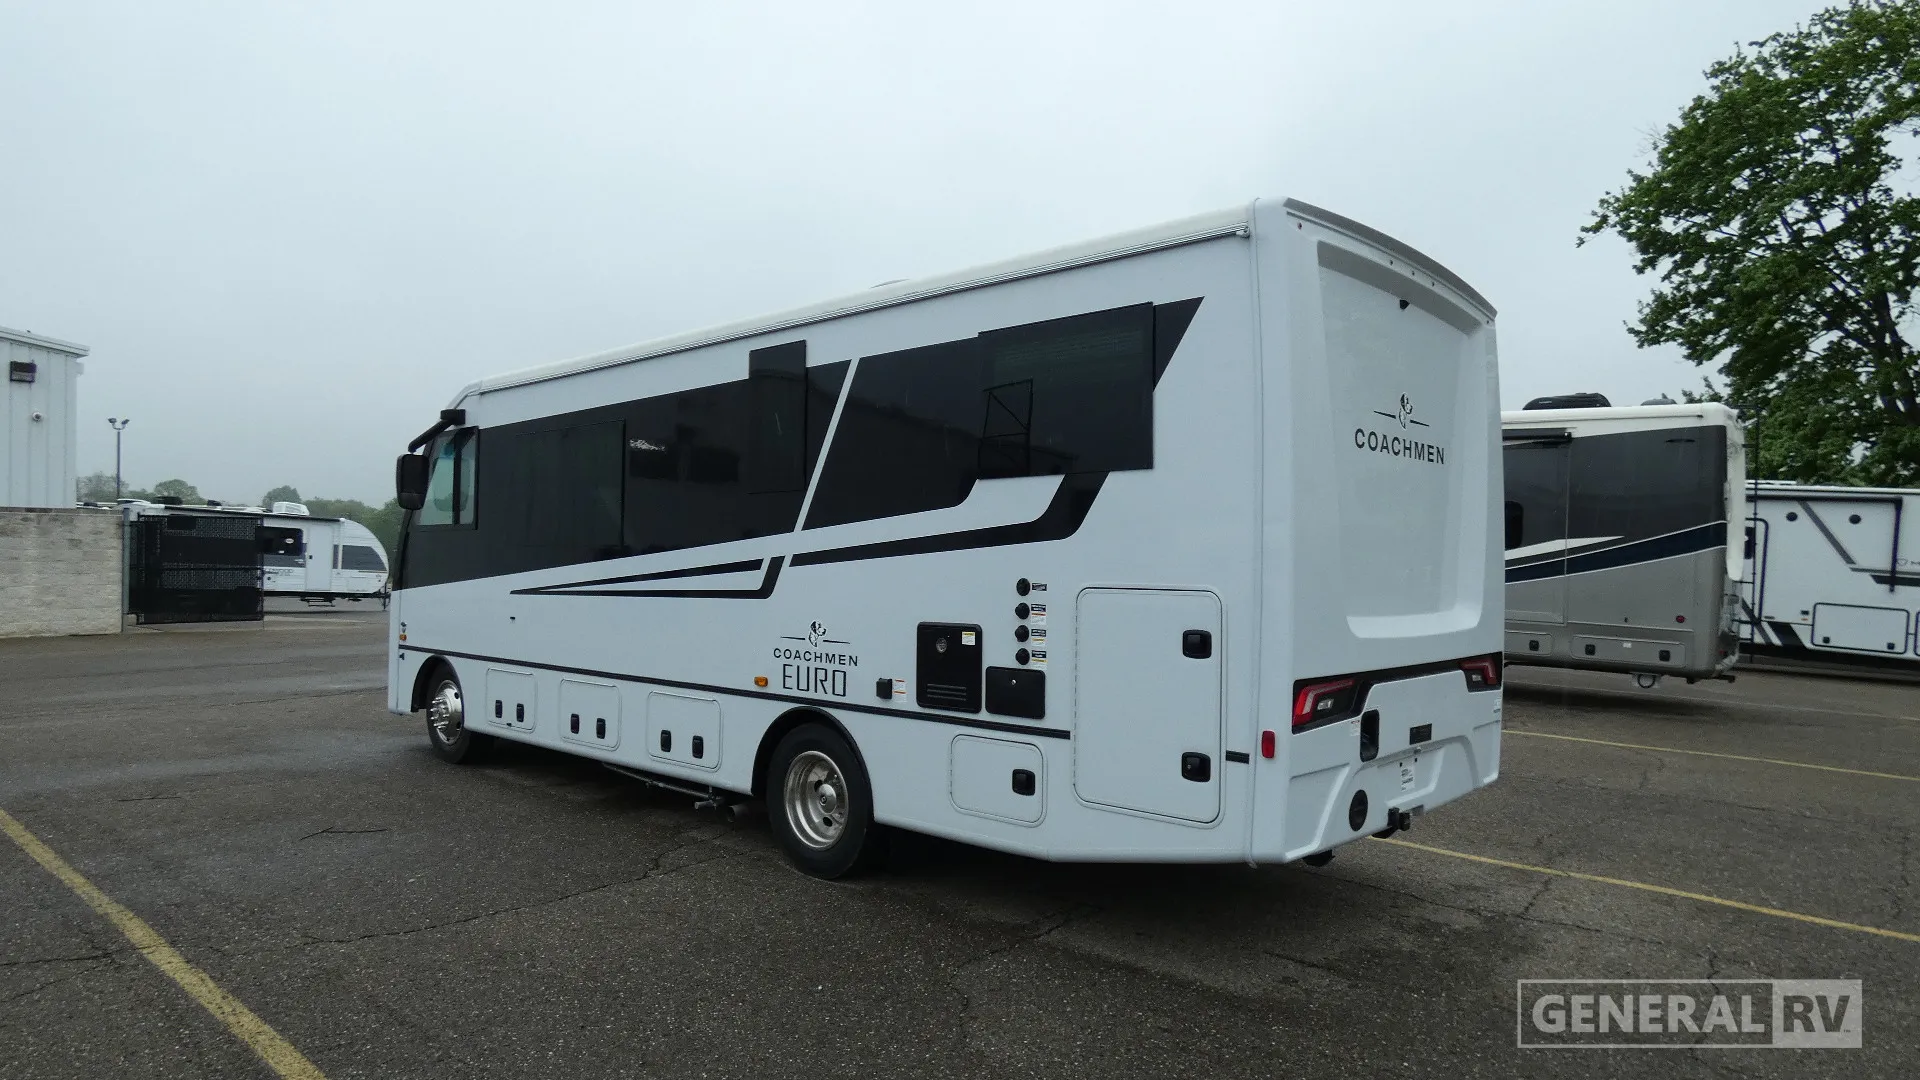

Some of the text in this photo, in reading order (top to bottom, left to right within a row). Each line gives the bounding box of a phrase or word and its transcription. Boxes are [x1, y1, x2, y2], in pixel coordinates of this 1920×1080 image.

[1355, 428, 1444, 464] COACHMEN
[773, 648, 858, 666] COACHMEN
[783, 664, 846, 697] EURO
